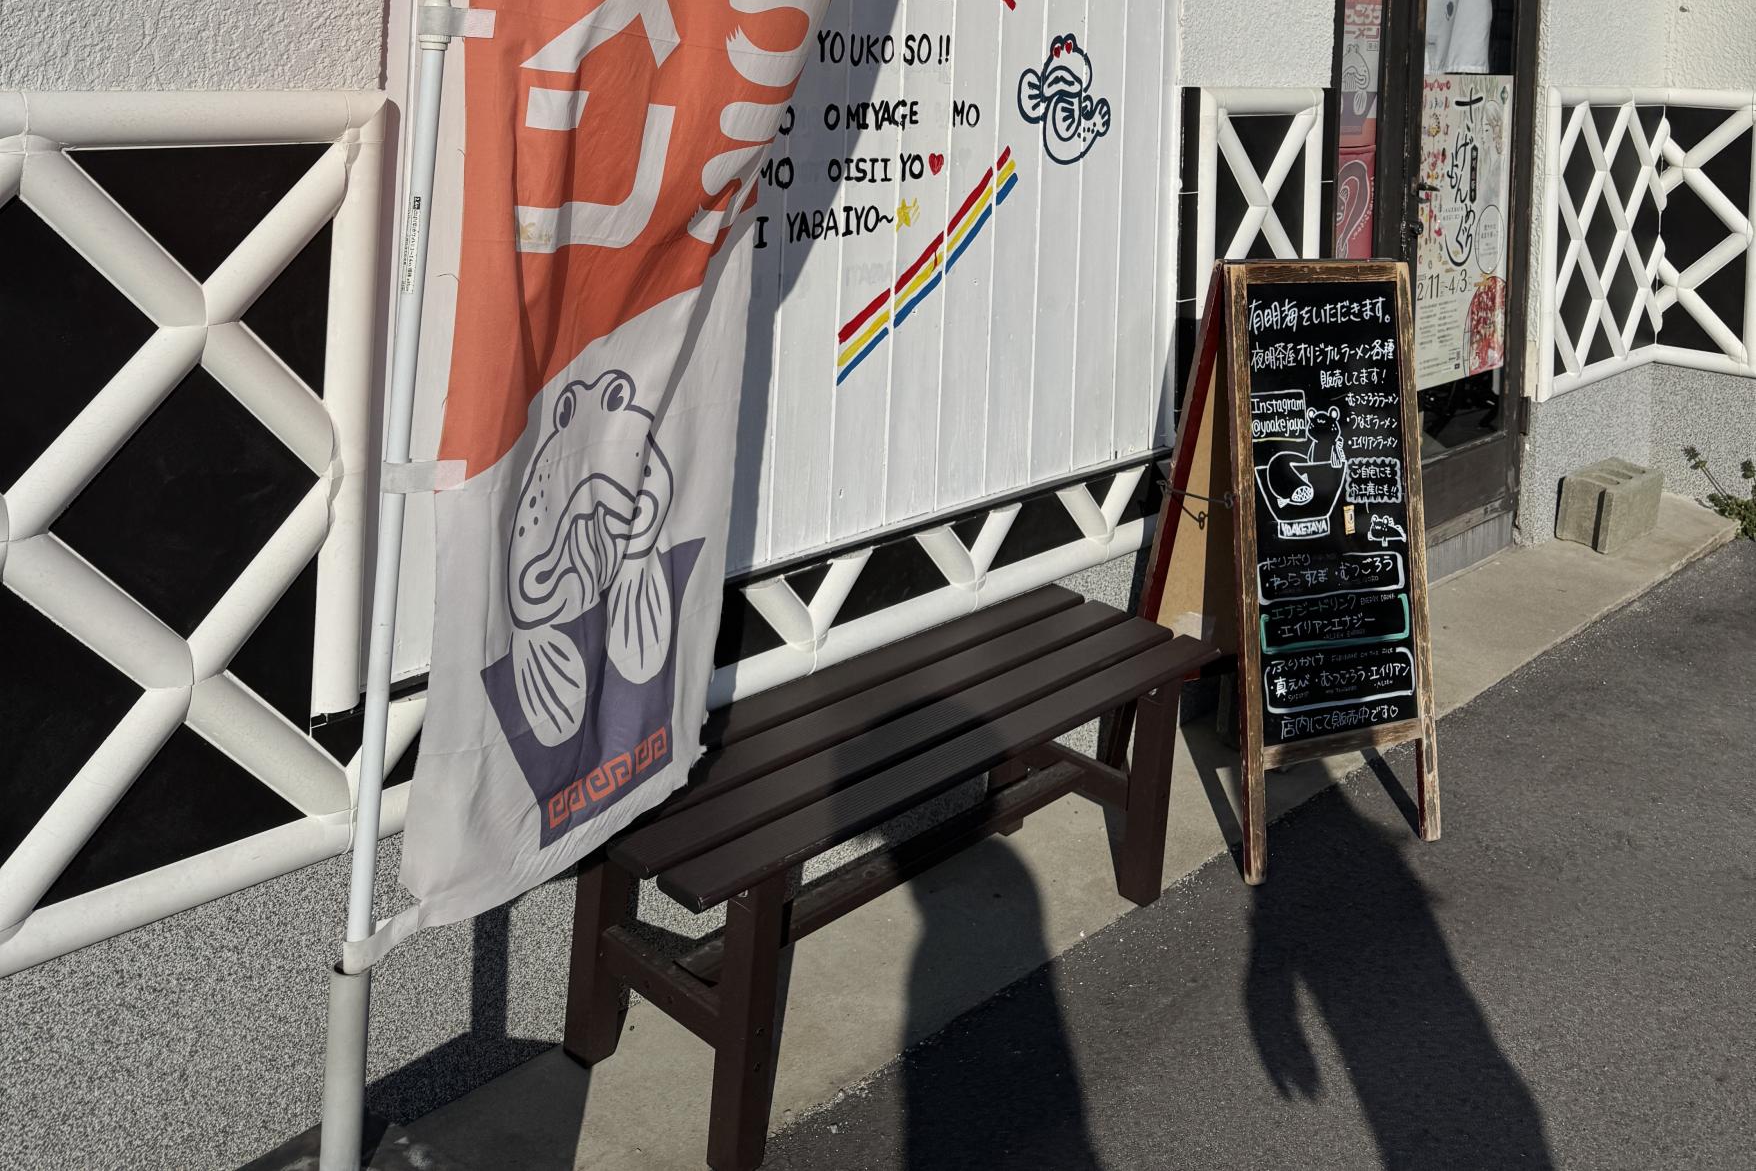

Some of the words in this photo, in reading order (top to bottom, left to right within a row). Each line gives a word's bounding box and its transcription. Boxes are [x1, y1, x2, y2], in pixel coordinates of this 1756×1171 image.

[824, 99, 919, 132] OMIYAGE
[952, 101, 980, 128] MO
[1249, 297, 1391, 335] 有明海をいただきます。
[1251, 398, 1304, 414] Instagram
[1272, 594, 1356, 620] エナジードリンク
[1271, 653, 1324, 674] ふりかけ
